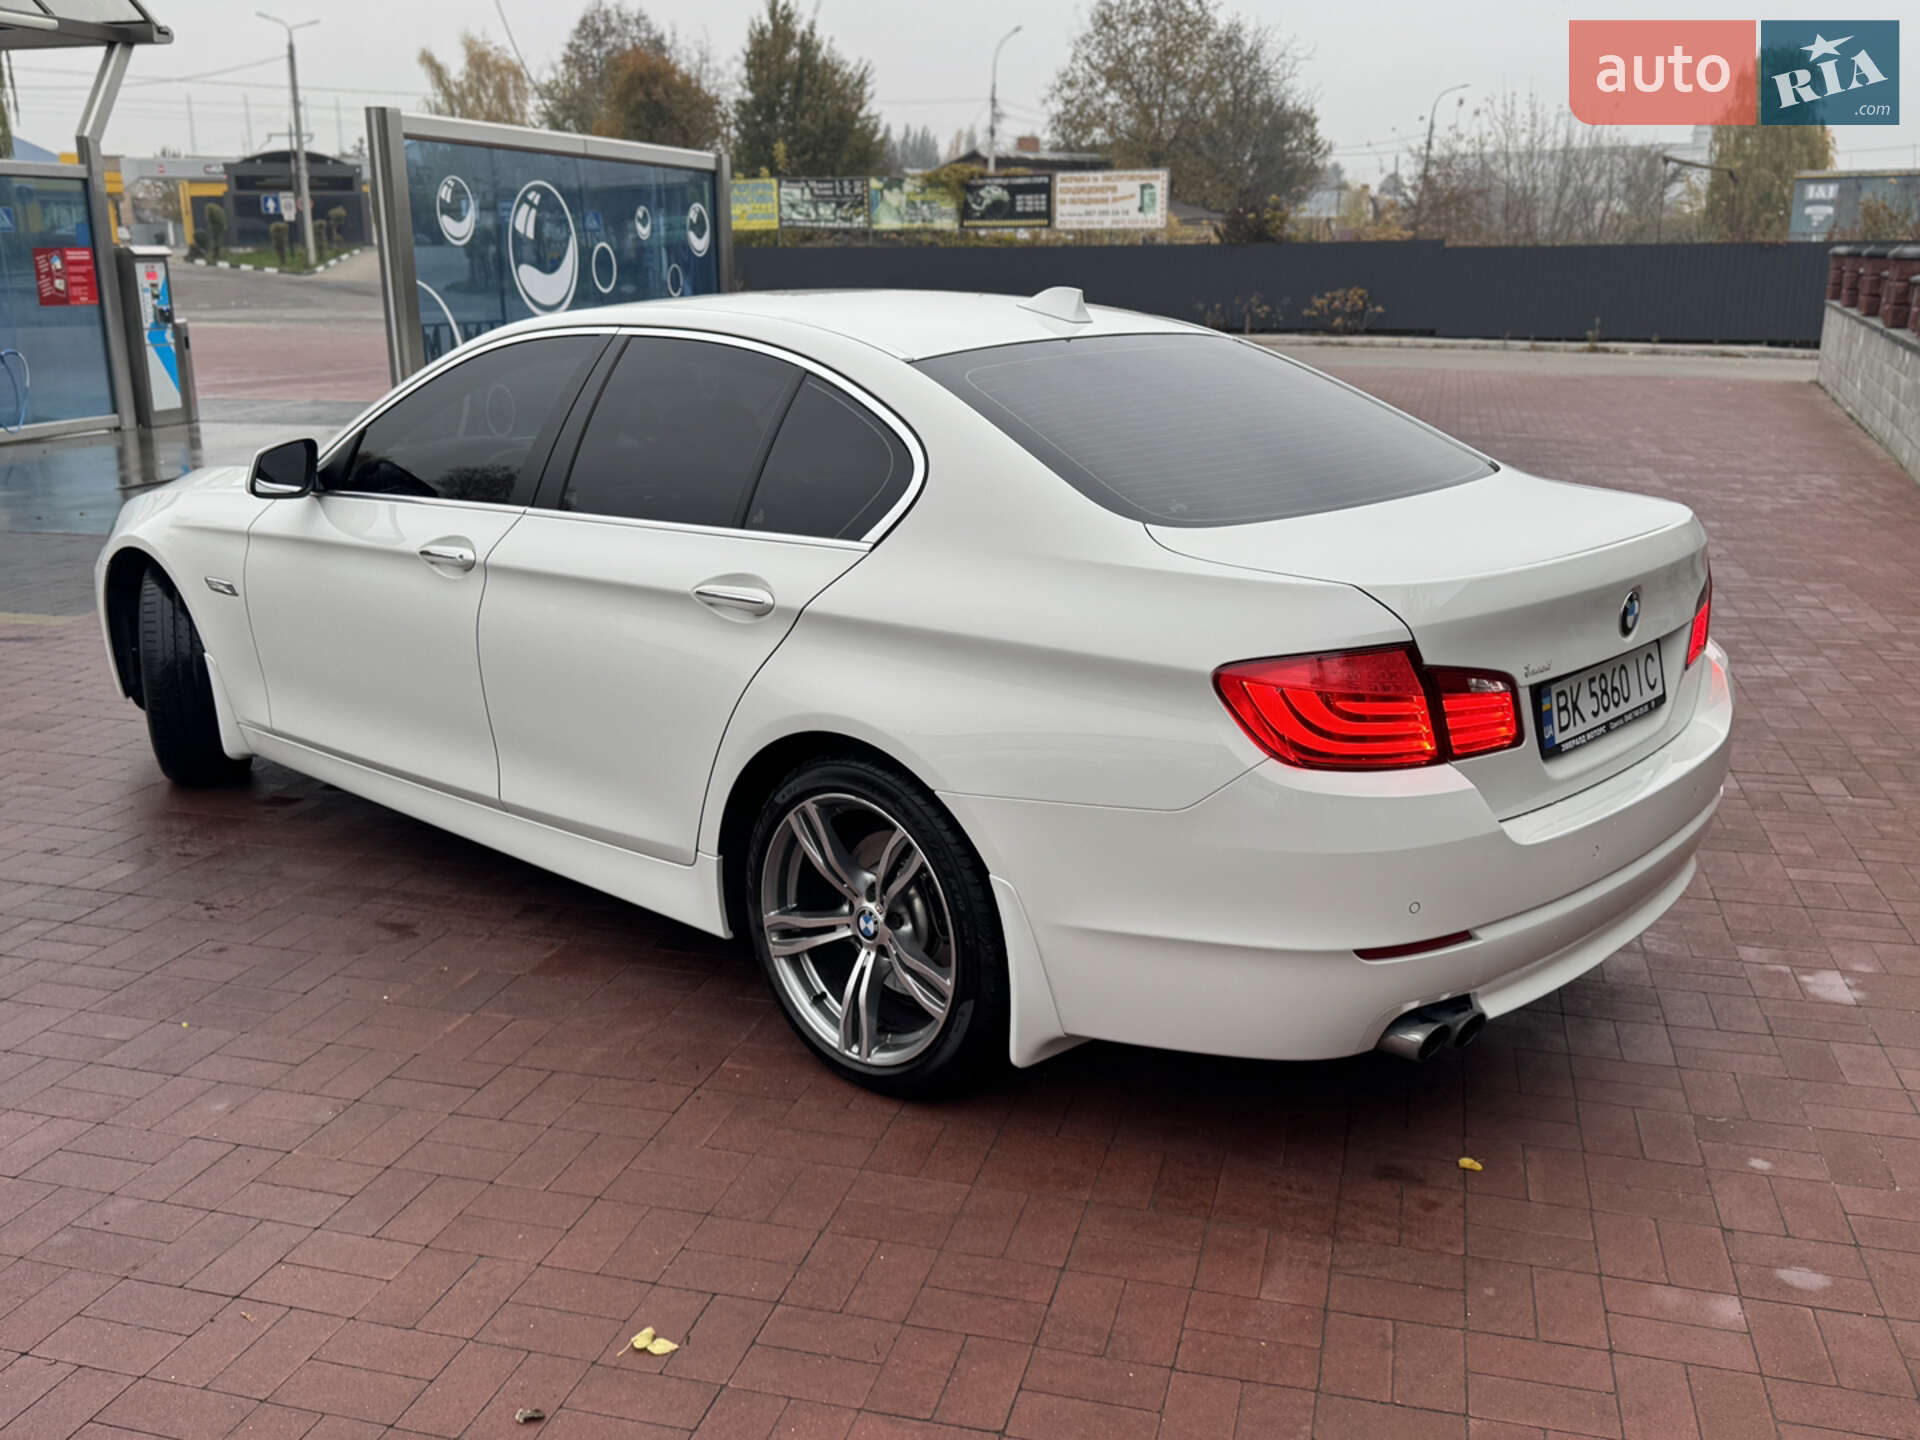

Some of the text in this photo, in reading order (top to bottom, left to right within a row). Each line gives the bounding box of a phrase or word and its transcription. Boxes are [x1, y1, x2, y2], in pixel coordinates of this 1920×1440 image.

[1555, 682, 1586, 734] BK
[1588, 663, 1630, 718] 5860
[1635, 653, 1658, 696] IC
[1543, 725, 1553, 739] UA
